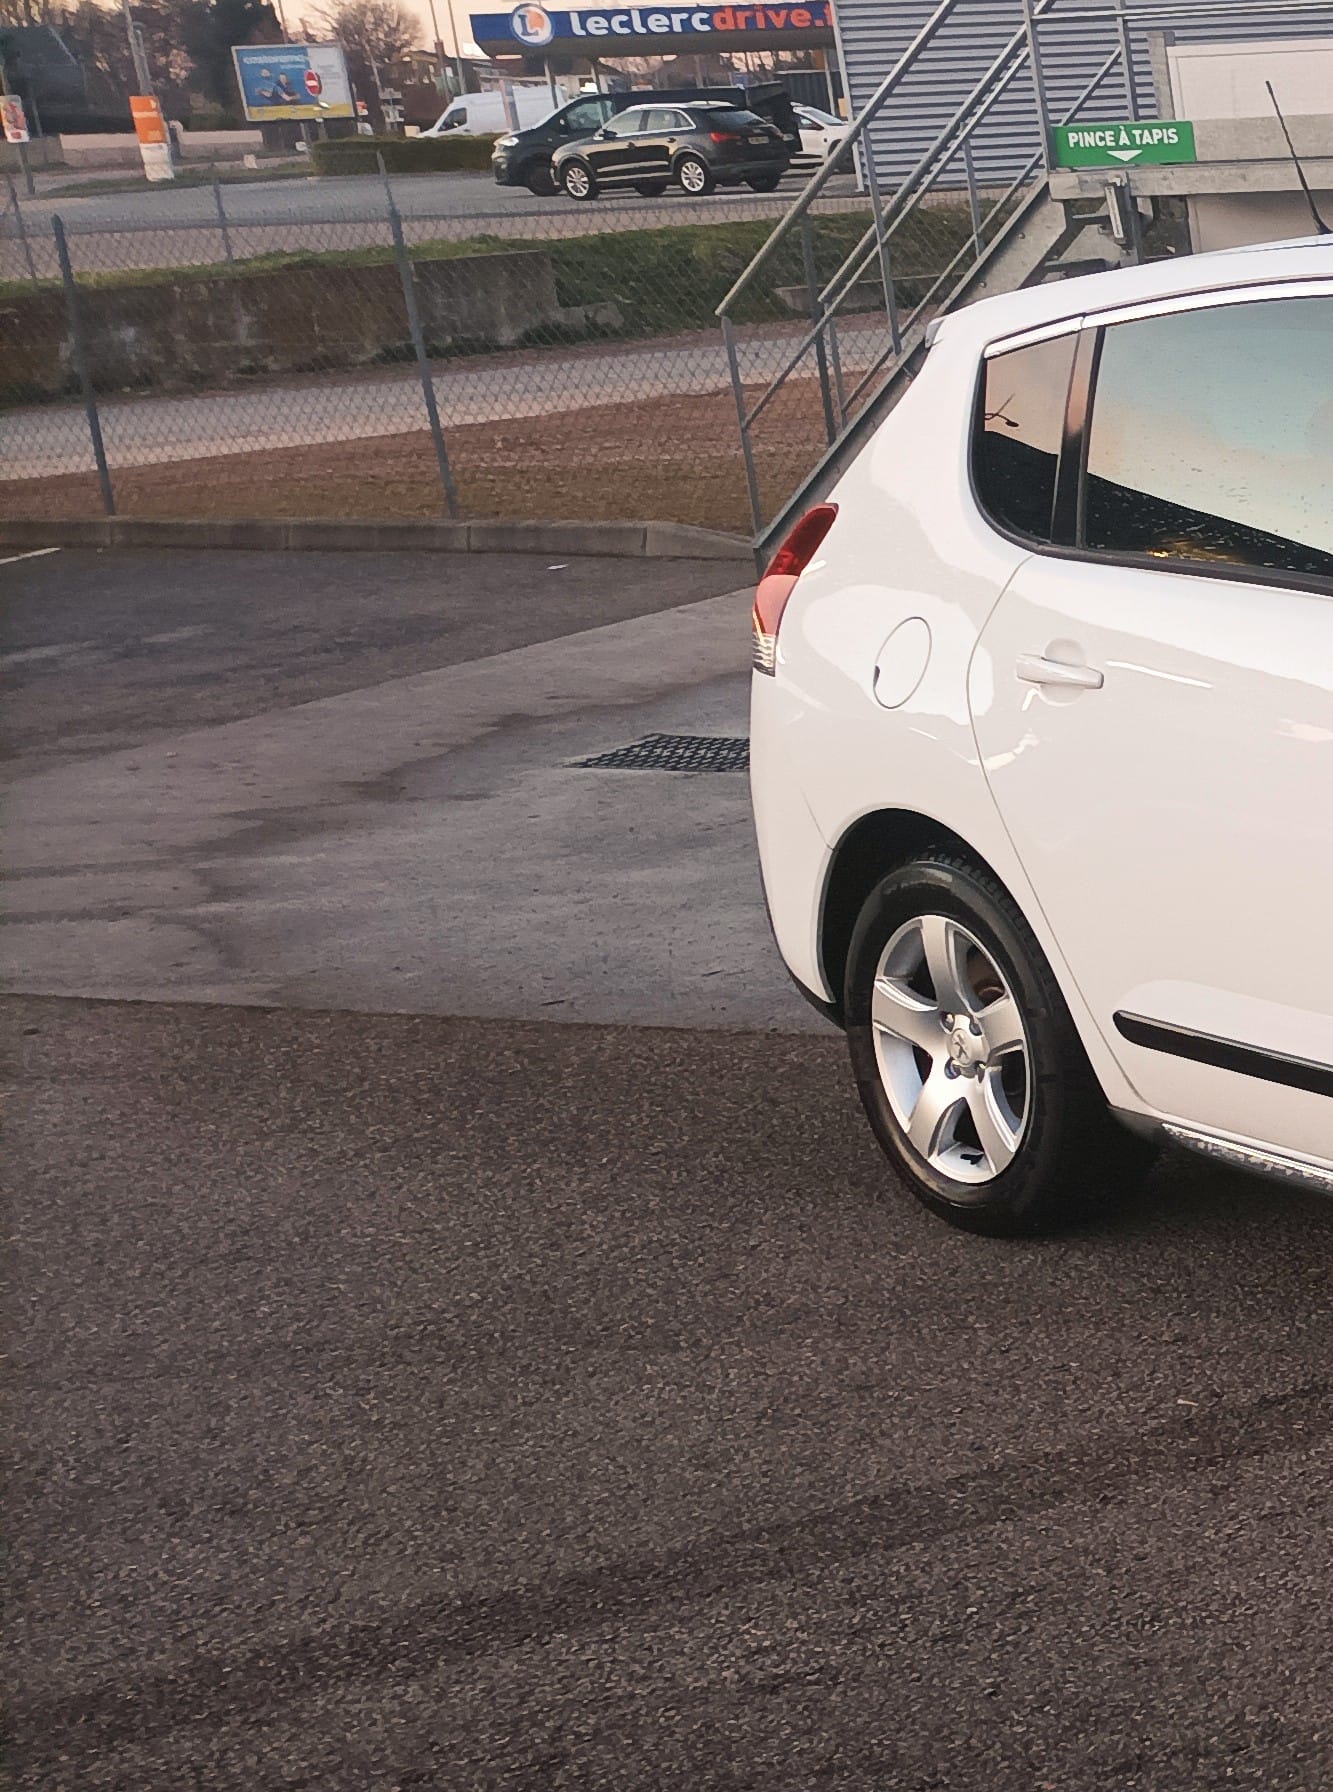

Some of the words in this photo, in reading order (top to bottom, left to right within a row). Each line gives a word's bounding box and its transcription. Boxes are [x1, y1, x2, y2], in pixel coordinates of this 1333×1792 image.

[1068, 131, 1116, 148] PINCE
[1119, 125, 1131, 146] À
[1132, 128, 1179, 145] TAPIS
